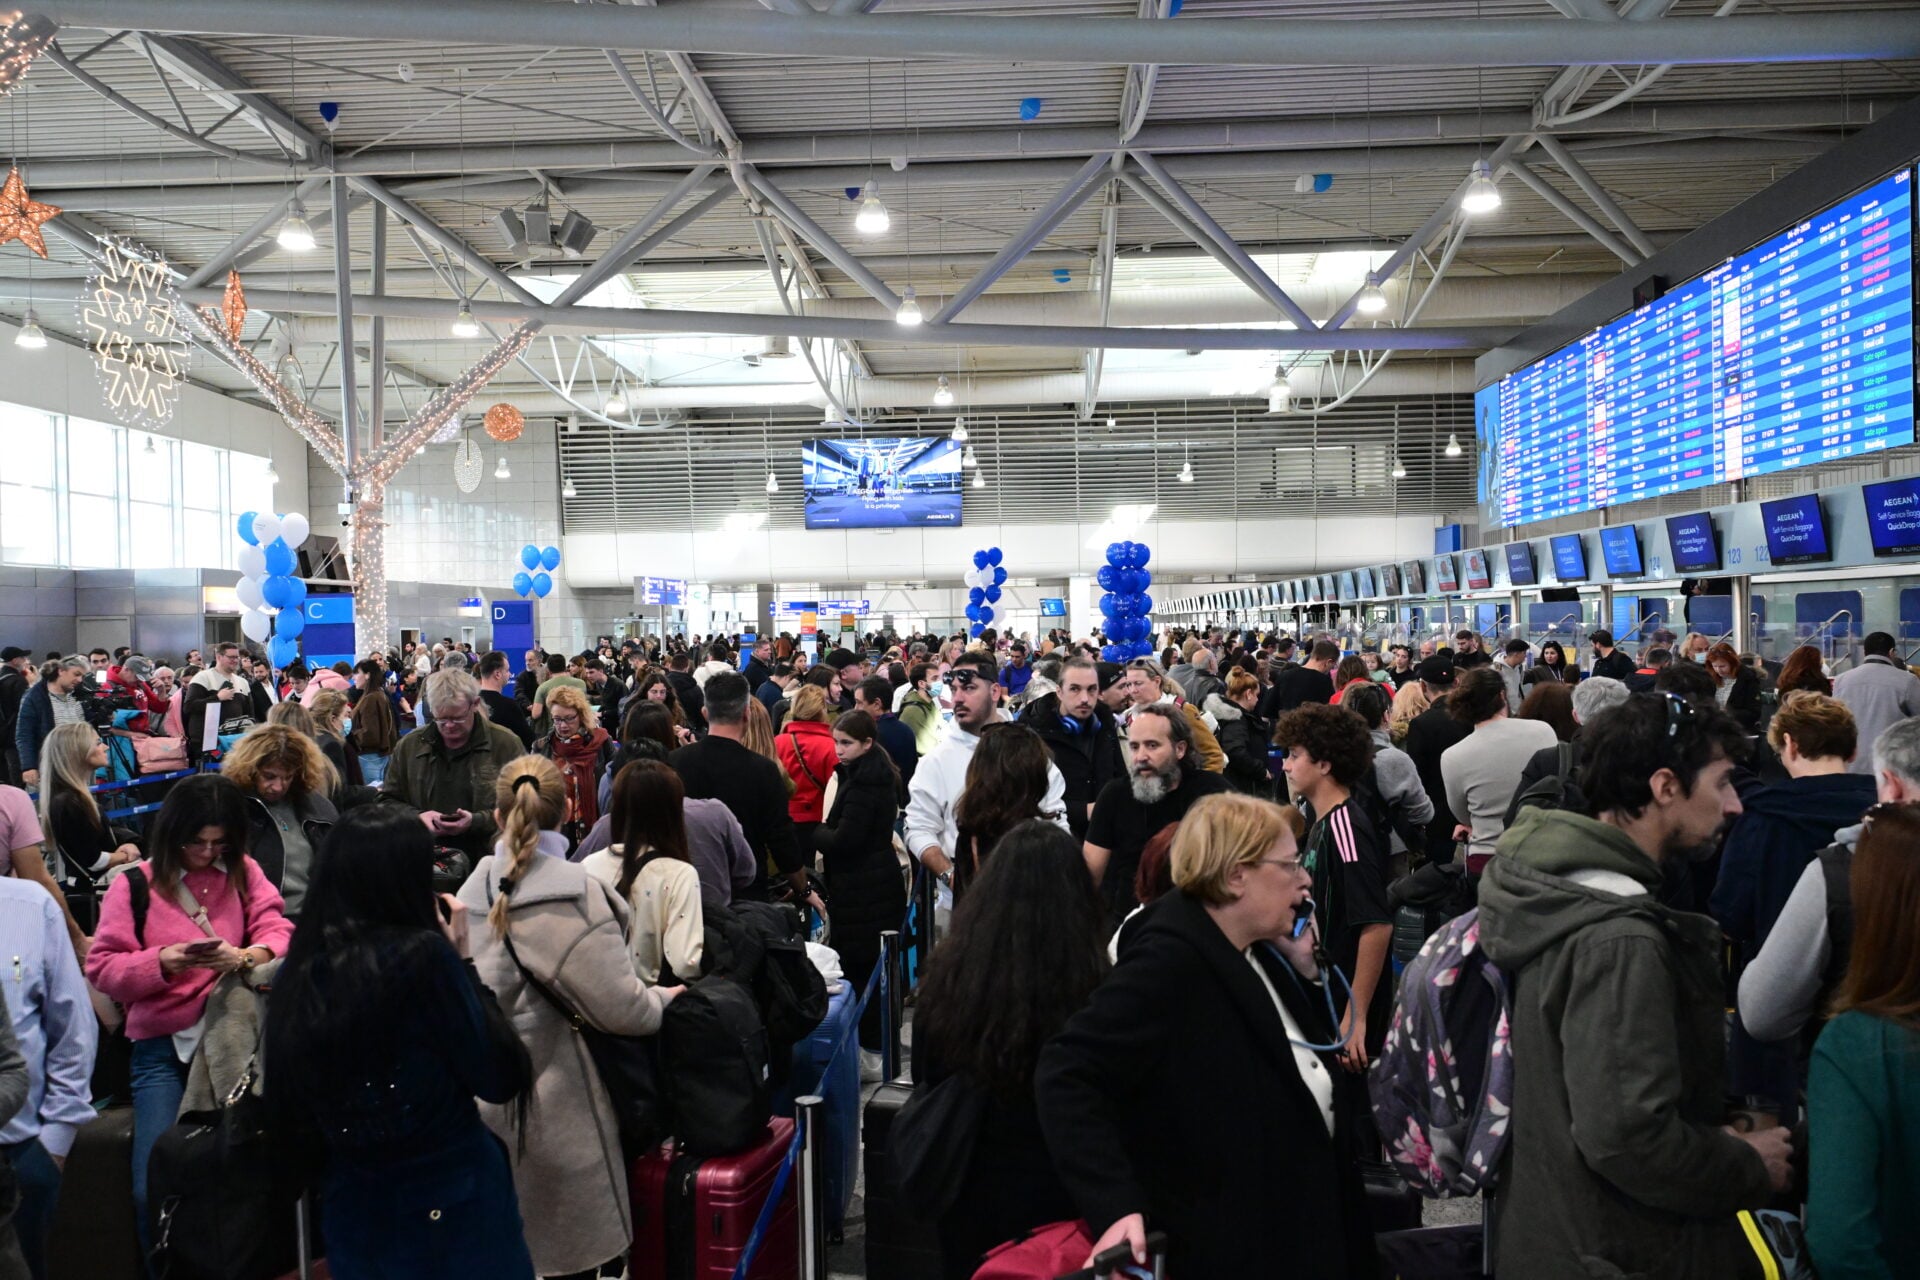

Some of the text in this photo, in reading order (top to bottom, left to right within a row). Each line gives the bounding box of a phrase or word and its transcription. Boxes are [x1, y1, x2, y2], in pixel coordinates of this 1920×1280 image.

[1884, 496, 1912, 507] AEGEAN
[1776, 513, 1799, 522] AEGEAN
[1888, 522, 1916, 530] QuickDrop
[1728, 548, 1741, 564] 123
[308, 603, 323, 619] C
[494, 608, 506, 620] D
